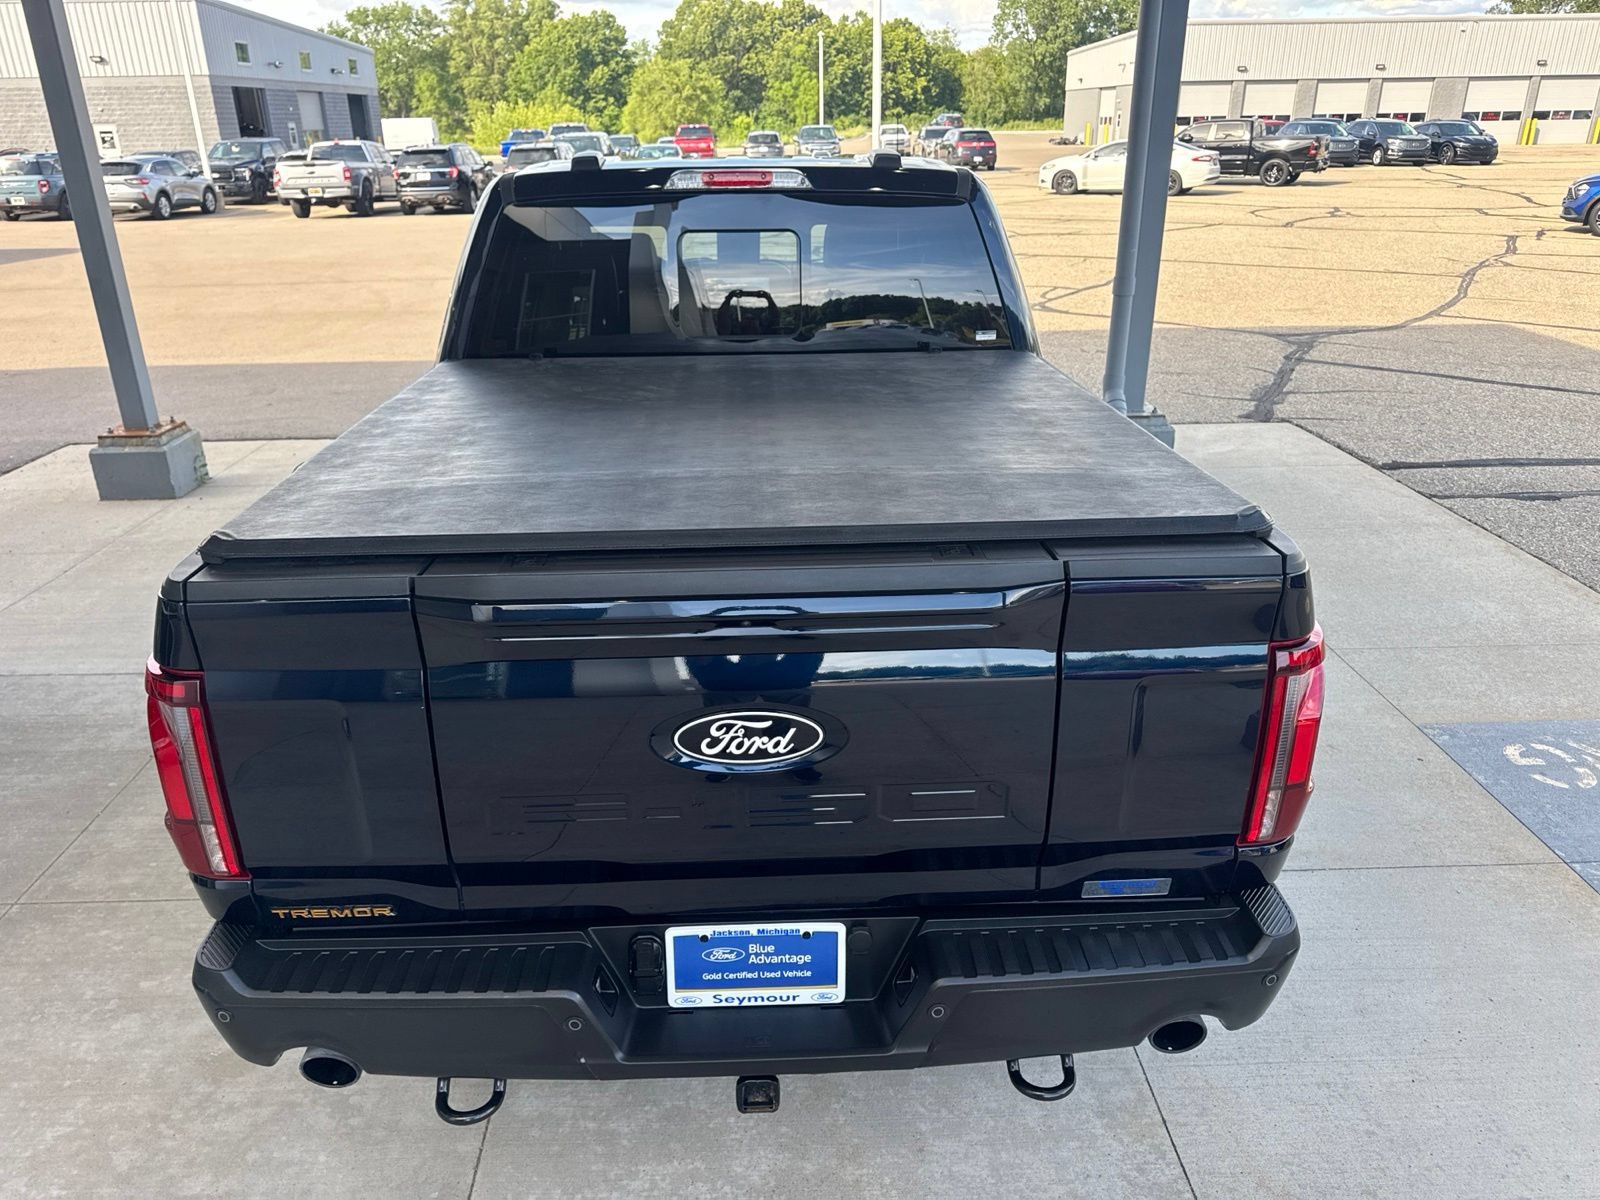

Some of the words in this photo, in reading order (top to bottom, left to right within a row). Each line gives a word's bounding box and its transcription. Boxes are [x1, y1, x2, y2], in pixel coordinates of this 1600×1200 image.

[700, 719, 797, 755] Ford
[271, 904, 397, 919] TREMOR
[710, 929, 754, 937] Jackson,
[757, 928, 800, 936] Michigan
[748, 943, 775, 954] Blue
[710, 949, 738, 960] Ford
[748, 954, 812, 964] Advantage
[702, 972, 722, 980] Gold
[724, 971, 758, 979] Certified
[760, 970, 780, 978] Used
[783, 969, 812, 977] Vehicle
[712, 993, 800, 1006] Seymour
